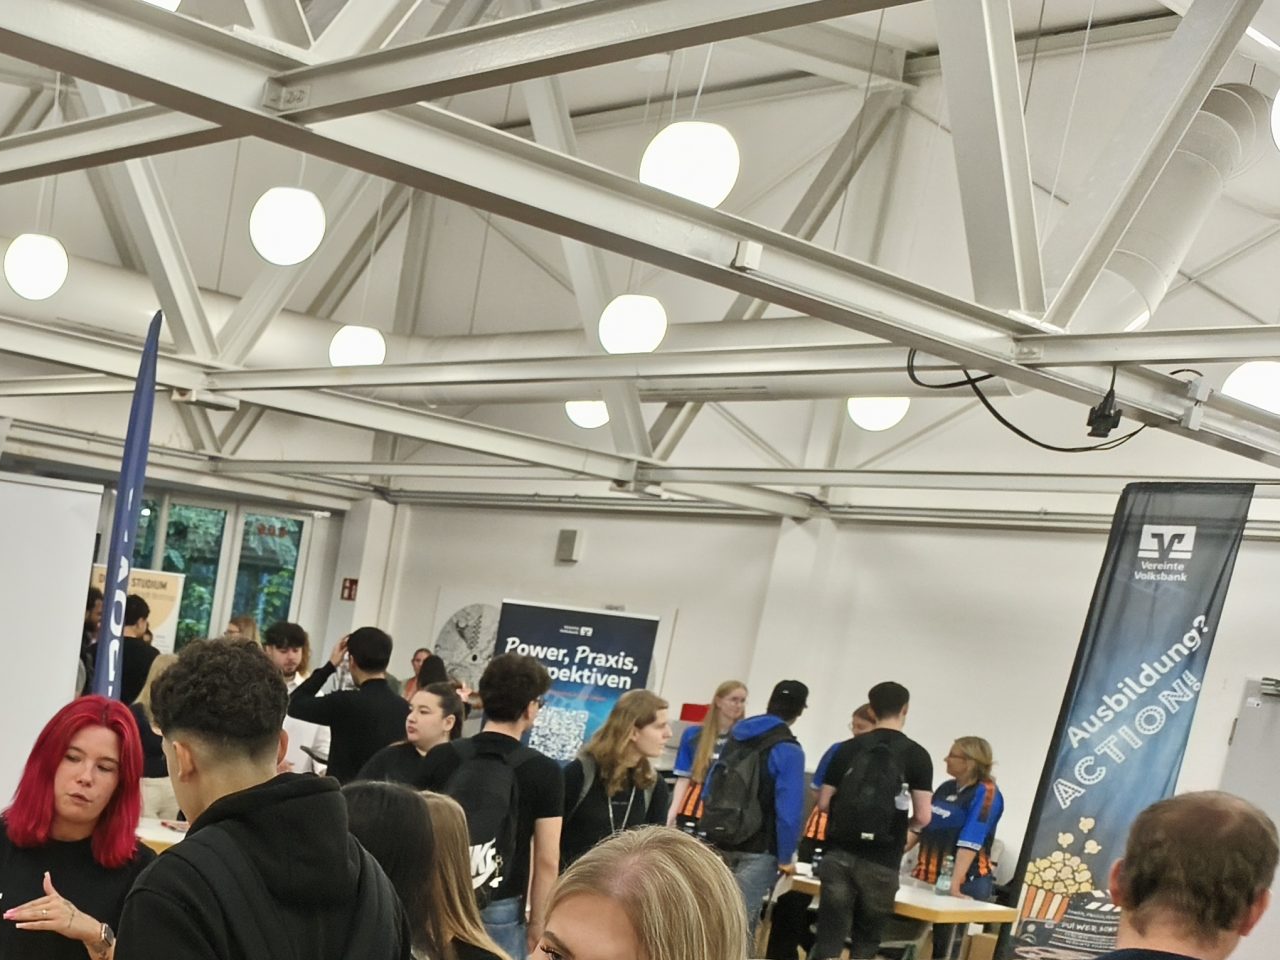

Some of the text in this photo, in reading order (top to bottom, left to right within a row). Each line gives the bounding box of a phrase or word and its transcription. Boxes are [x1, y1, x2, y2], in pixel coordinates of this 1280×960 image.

[1134, 571, 1188, 582] Volksbank
[1141, 561, 1185, 571] Vereinte
[131, 577, 168, 590] STUDIUM
[505, 637, 570, 665] Power,
[574, 646, 639, 674] Praxis,
[547, 666, 632, 690] pektiven
[1067, 614, 1208, 748] Ausbildung?
[1053, 670, 1201, 809] ACTION!
